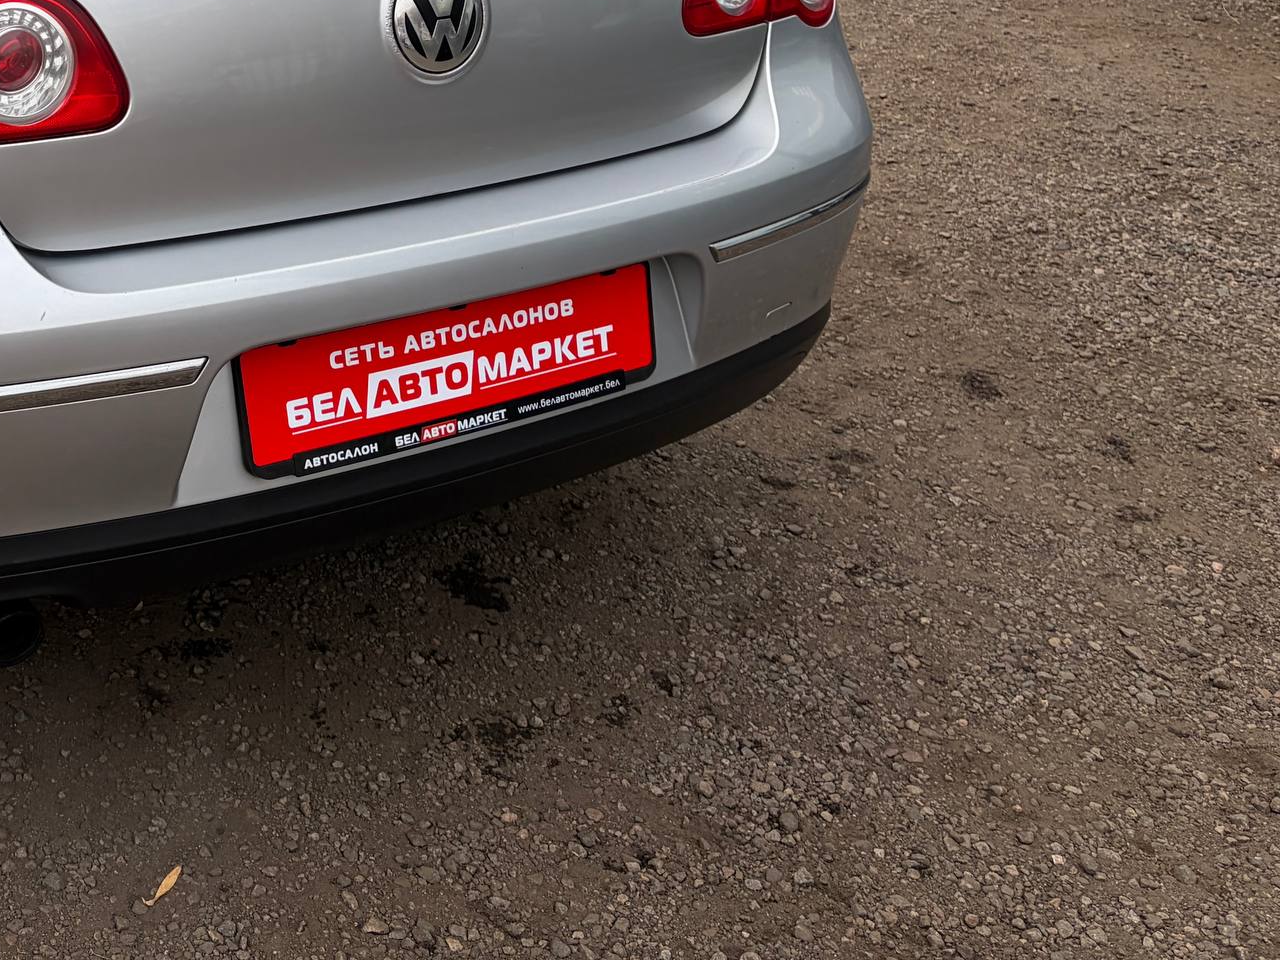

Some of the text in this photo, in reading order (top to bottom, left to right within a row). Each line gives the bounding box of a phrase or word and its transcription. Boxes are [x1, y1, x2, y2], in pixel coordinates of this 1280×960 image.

[329, 298, 574, 370] СЕТЬ АВТОСАЛОНОВ
[518, 378, 621, 414] www.белавтомаркет.бел
[304, 442, 379, 470] АВТОСАЛОН
